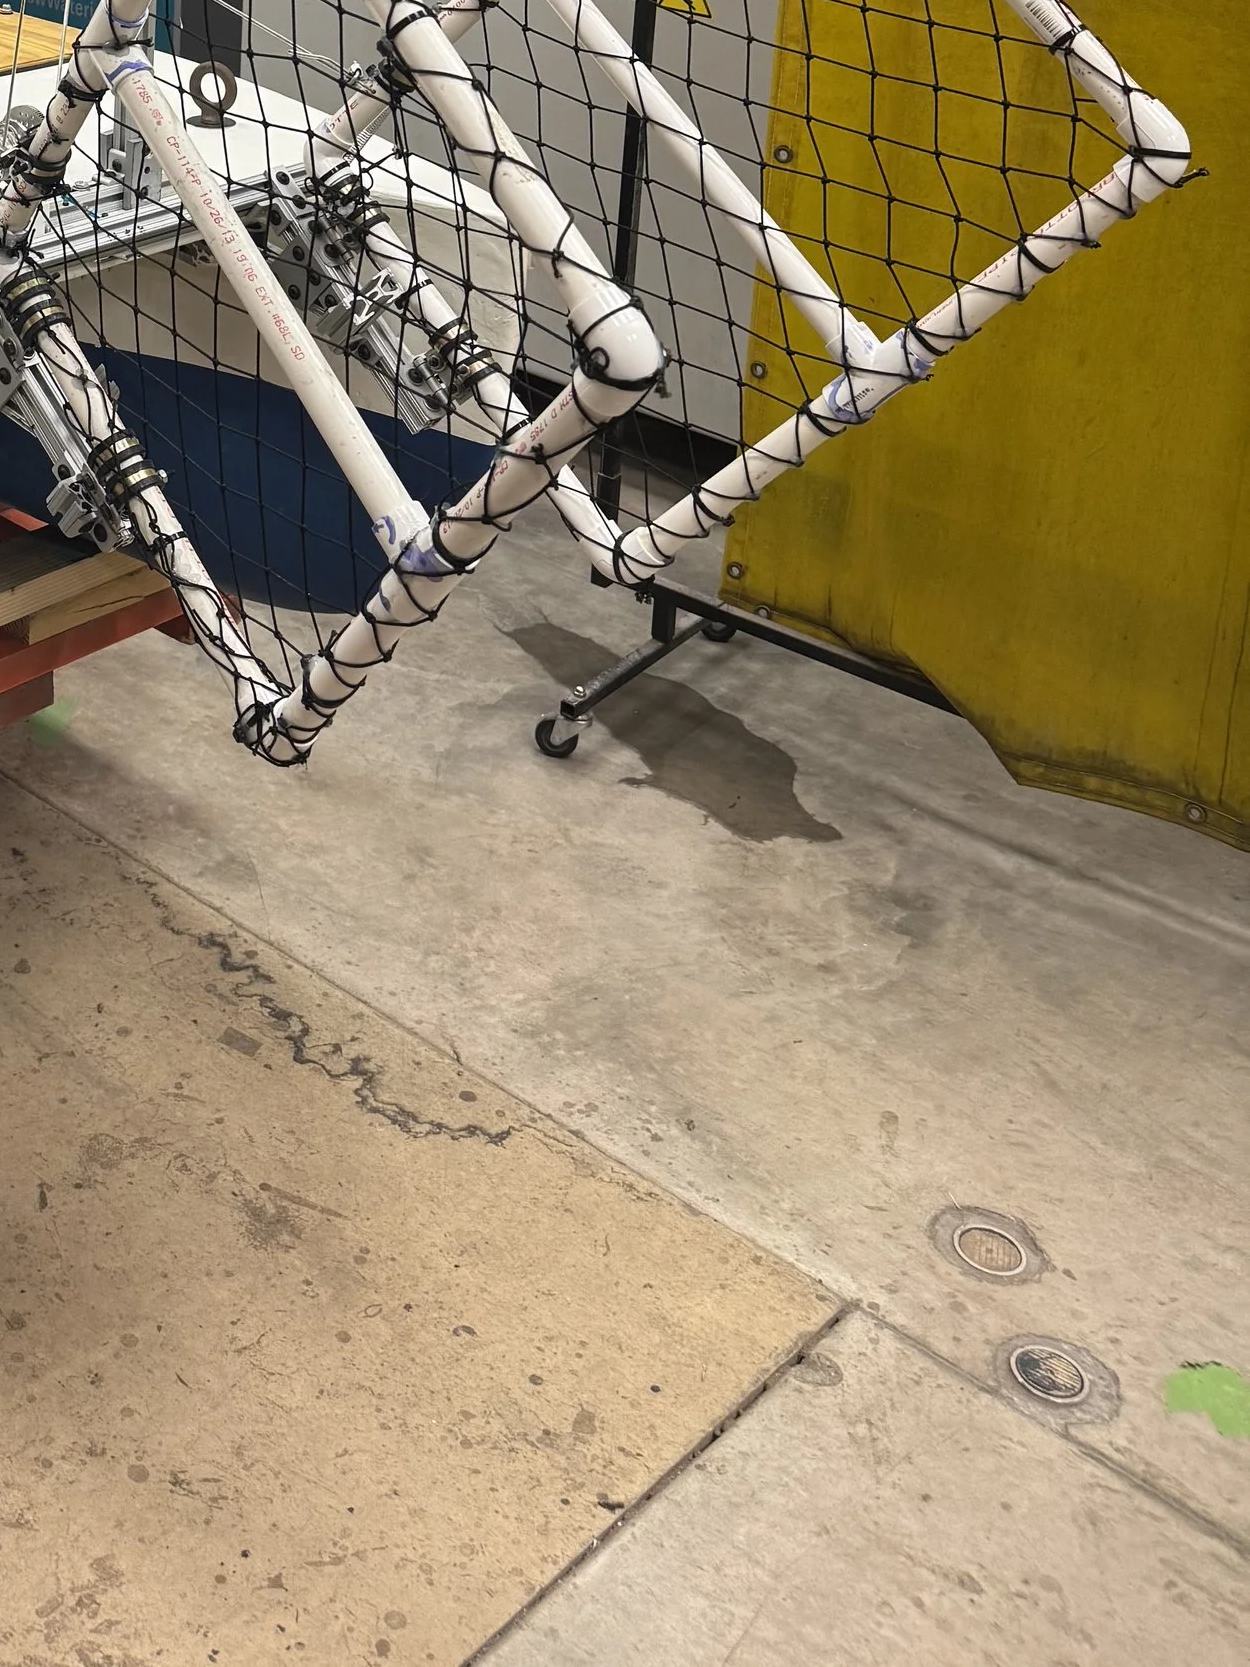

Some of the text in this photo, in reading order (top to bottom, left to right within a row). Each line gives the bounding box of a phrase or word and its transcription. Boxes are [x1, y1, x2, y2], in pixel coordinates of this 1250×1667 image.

[132, 77, 153, 104] 1785
[200, 191, 237, 245] 10/26/13
[290, 344, 306, 362] SD
[530, 419, 548, 443] 1785
